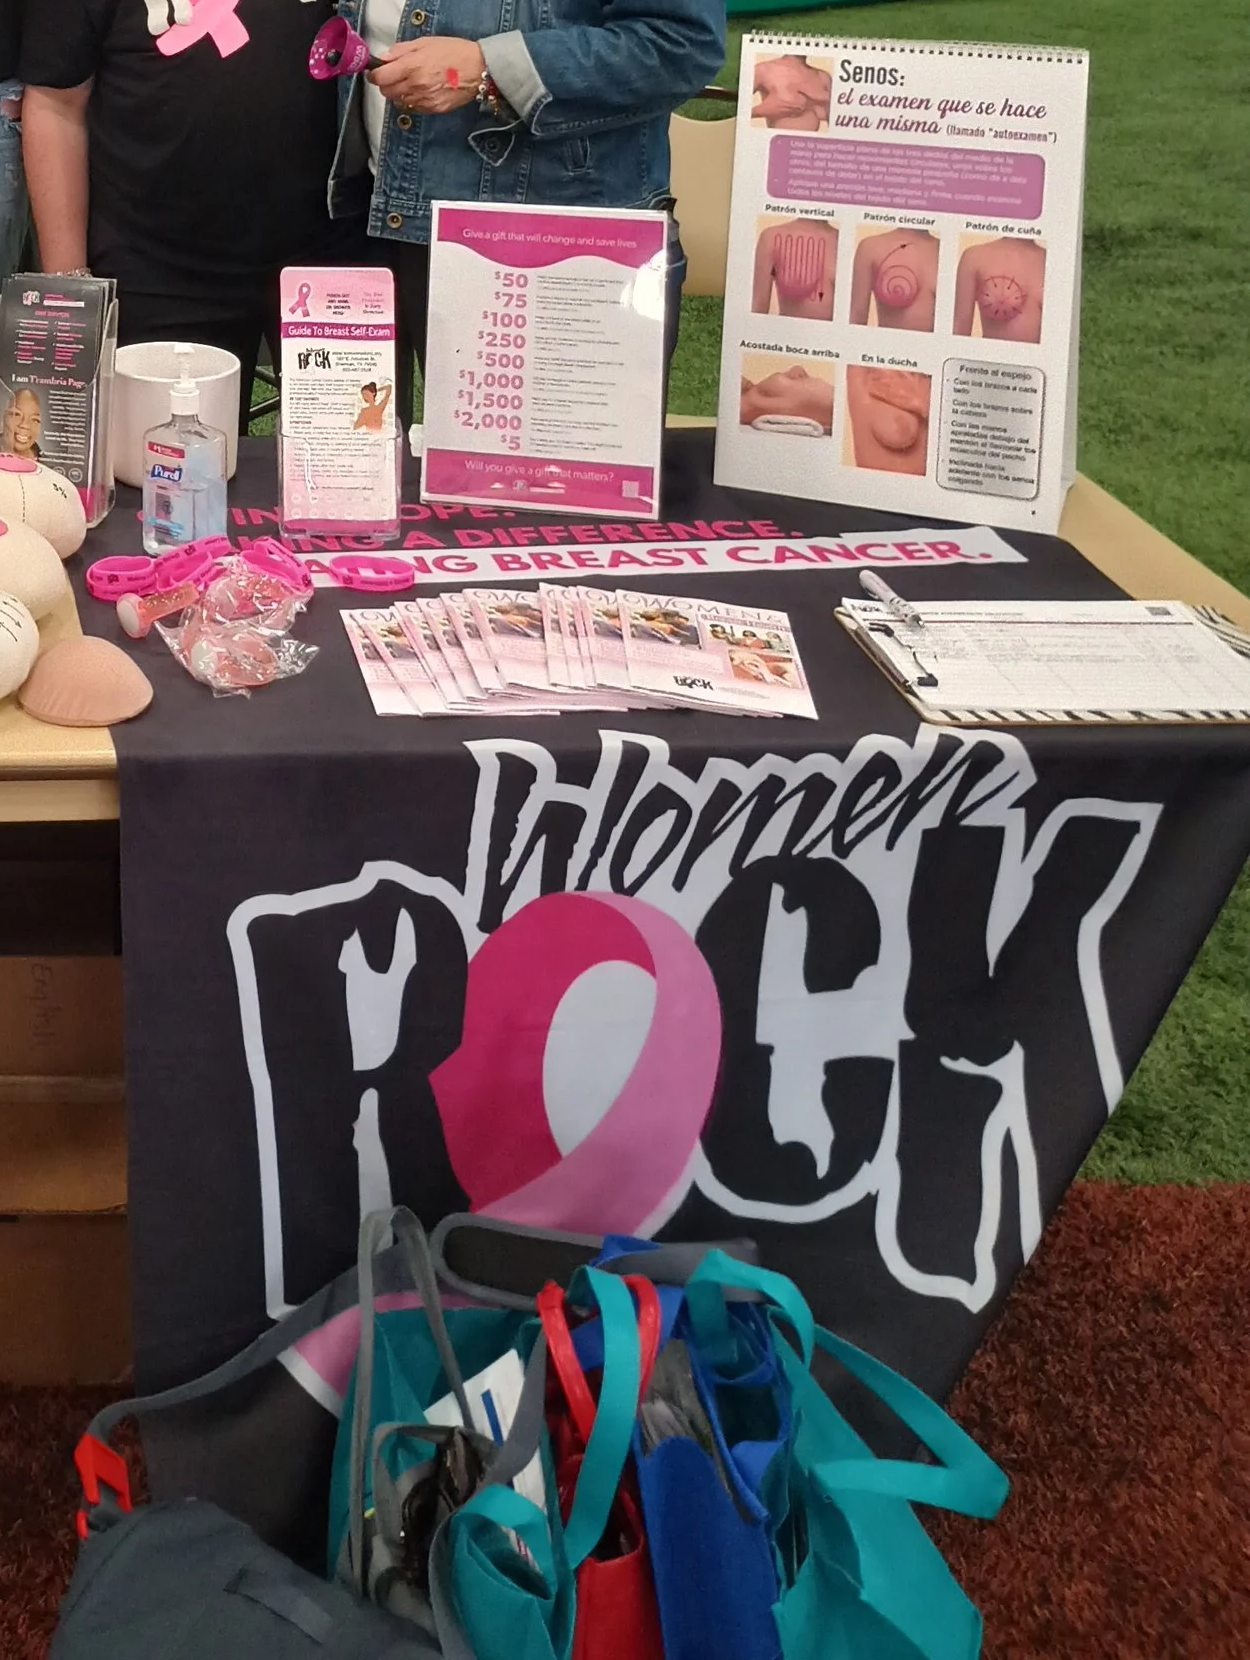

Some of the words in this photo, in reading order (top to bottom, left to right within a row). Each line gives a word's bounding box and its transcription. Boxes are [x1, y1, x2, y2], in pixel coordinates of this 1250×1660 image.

[839, 59, 905, 87] Senos:
[837, 88, 853, 105] el
[859, 92, 932, 111] examen
[937, 98, 973, 119] que
[975, 102, 996, 116] se
[999, 98, 1047, 119] hace
[835, 114, 873, 129] una
[876, 114, 942, 134] misma
[765, 203, 797, 214] Patrón
[799, 205, 835, 217] vertical
[863, 212, 896, 224] Patrón
[898, 215, 936, 226] circular
[965, 220, 999, 232] Patrón
[1002, 225, 1015, 233] de
[463, 228, 484, 239] Give
[492, 230, 506, 242] gift
[507, 232, 524, 241] that
[525, 232, 541, 242] will
[542, 234, 575, 247] change
[576, 236, 594, 245] and
[596, 238, 616, 247] save
[617, 238, 637, 249] lives
[494, 271, 528, 289] $50
[494, 291, 528, 309] $75
[482, 310, 527, 329] $100
[288, 326, 312, 336] Guide
[313, 326, 323, 336] To
[323, 326, 350, 336] Breast
[350, 327, 391, 337] Self-Exam
[477, 330, 526, 349] $250
[739, 340, 783, 353] Acostada
[785, 345, 809, 355] boca
[811, 348, 840, 359] arriba
[477, 351, 525, 370] $500
[861, 354, 874, 363] En
[876, 355, 885, 364] la
[887, 356, 918, 368] ducha
[459, 369, 523, 390] $1,000
[458, 389, 523, 410] $1,500
[454, 409, 522, 431] $2,000
[501, 434, 521, 451] $5
[154, 465, 181, 481] Purell
[465, 460, 484, 471] Will
[484, 463, 503, 474] you
[504, 464, 526, 476] give
[573, 470, 614, 482] matters?
[399, 504, 516, 521] OPE.
[402, 530, 444, 549] A
[454, 519, 803, 549] DIFFERENCE.
[490, 546, 707, 572] BREAST
[725, 540, 993, 567] CANCER.
[470, 733, 1027, 934] Women
[228, 802, 1162, 1318] ROCK
